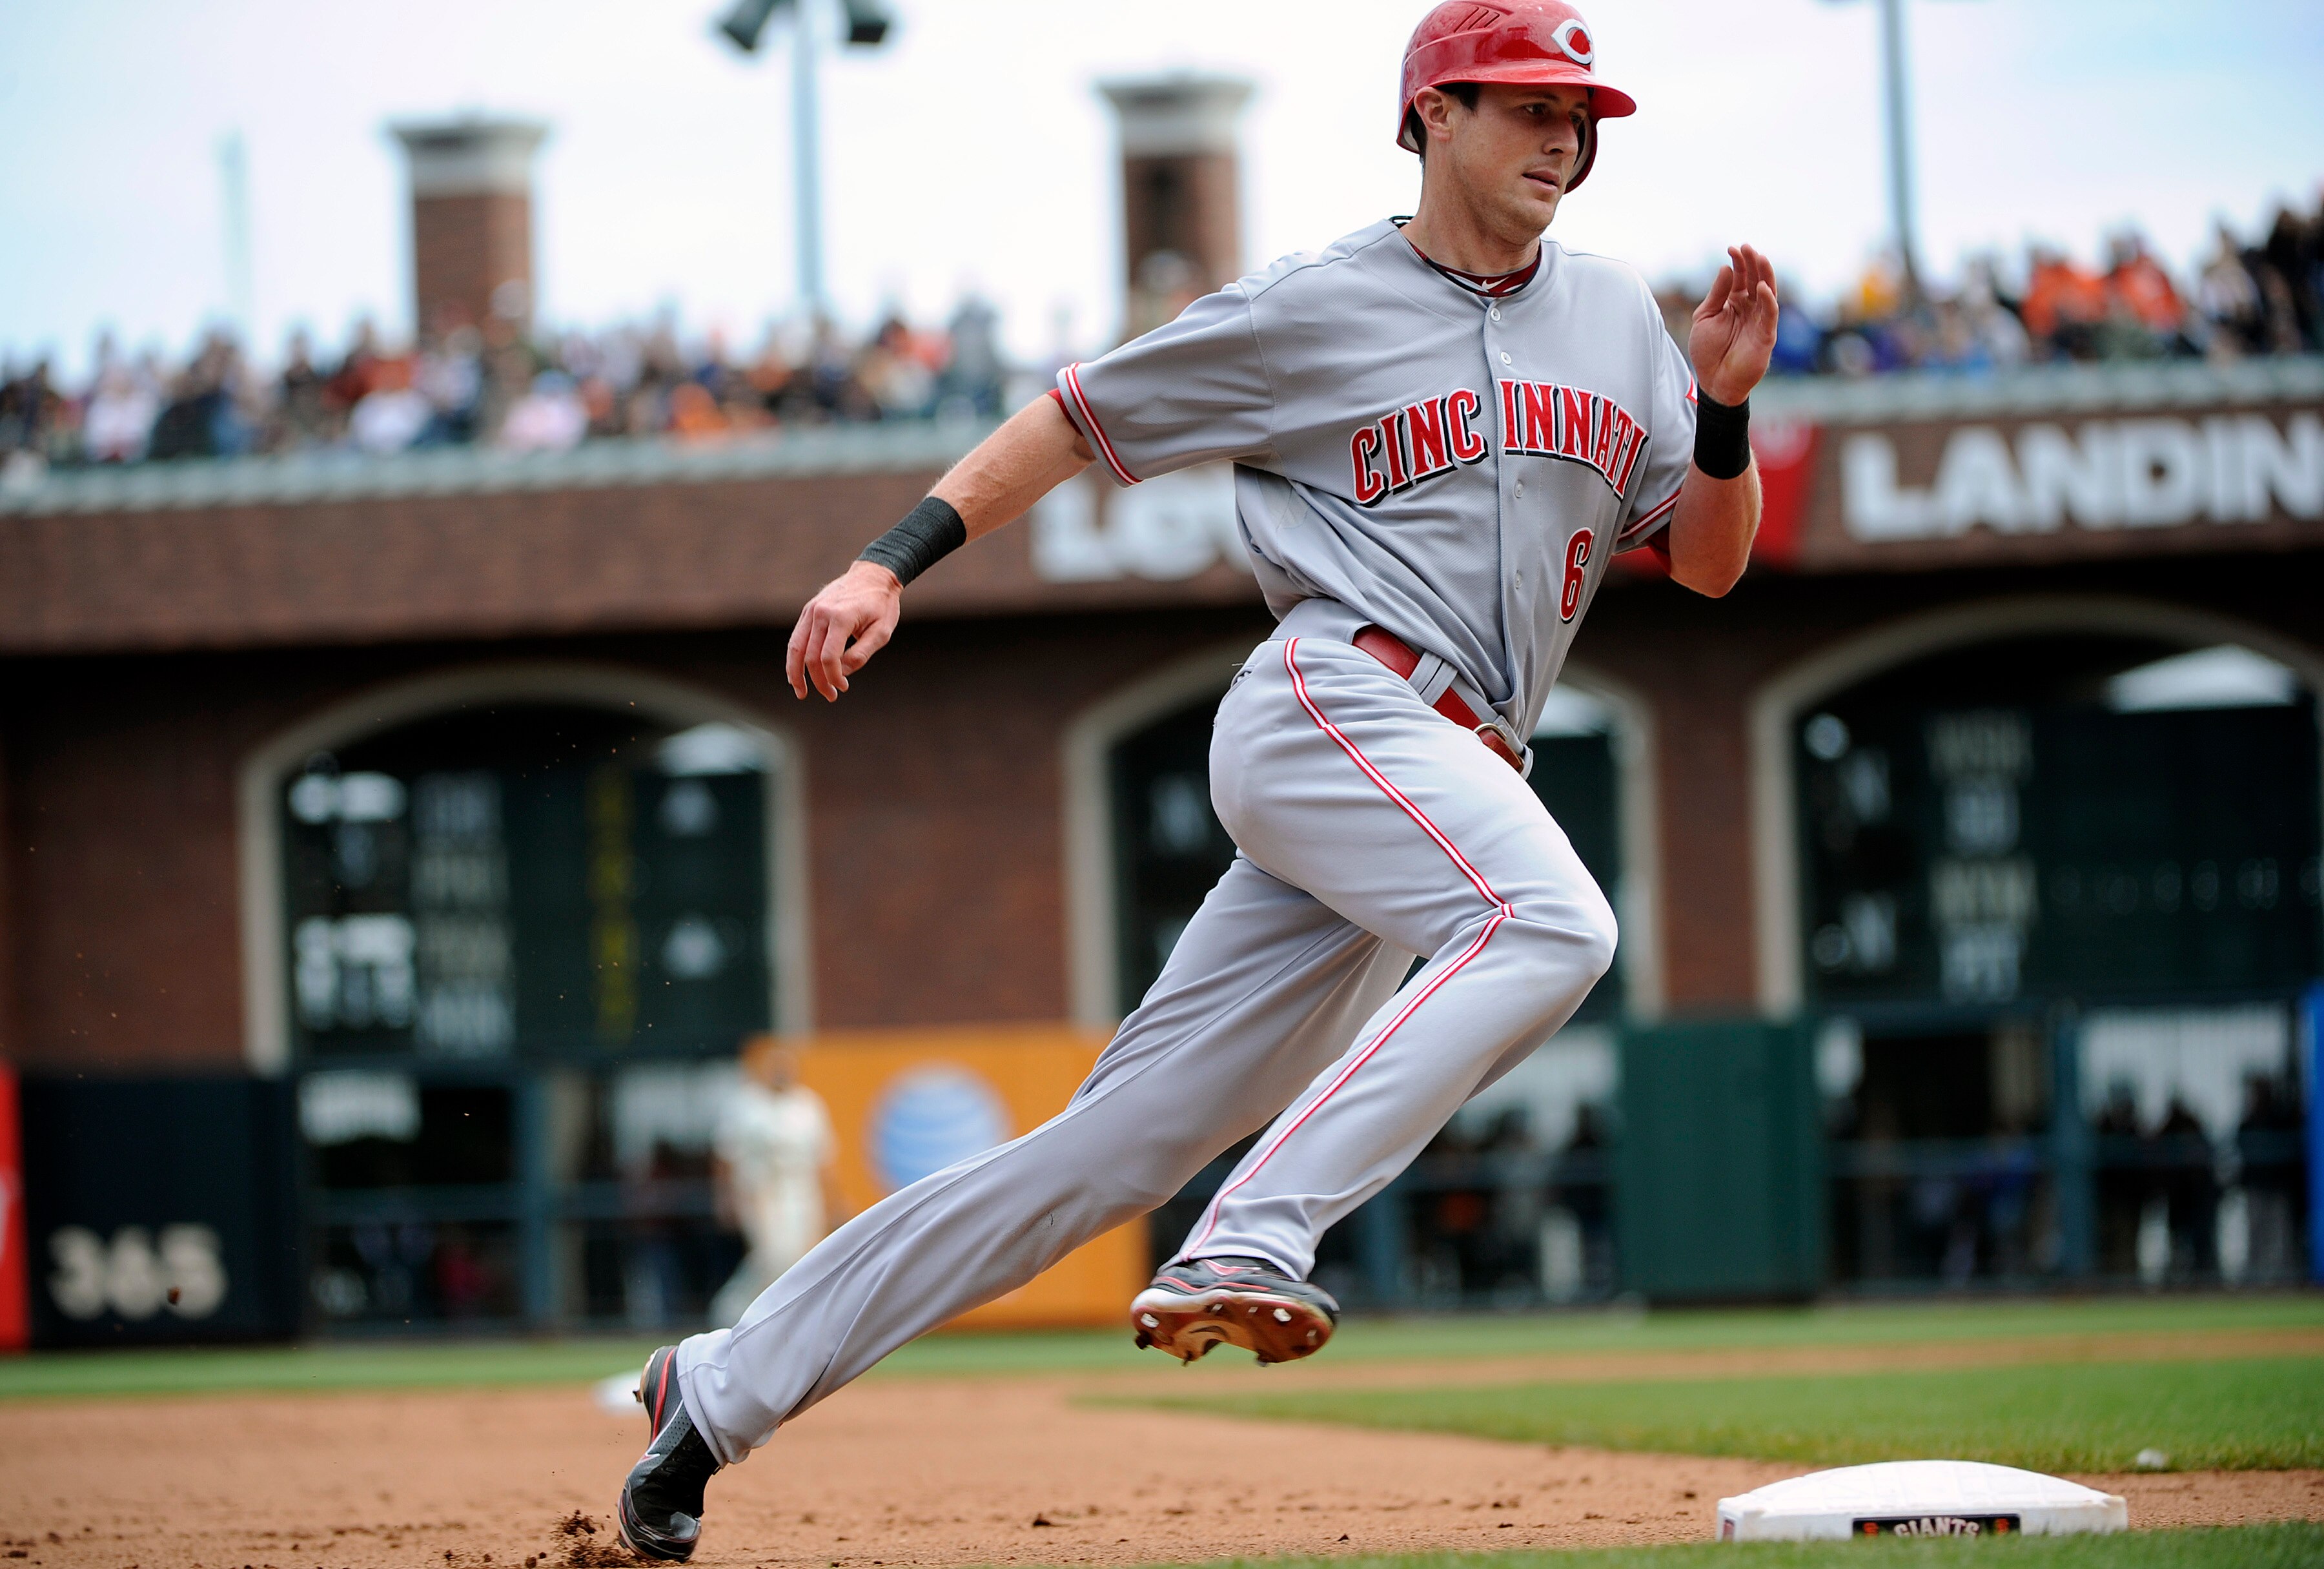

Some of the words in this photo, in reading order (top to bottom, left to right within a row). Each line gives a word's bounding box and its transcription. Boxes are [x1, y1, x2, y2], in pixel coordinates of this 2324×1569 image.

[1551, 19, 1593, 65] C
[1560, 527, 1595, 624] 6
[49, 1224, 226, 1321] 365
[1893, 1517, 1980, 1538] GIANTS
